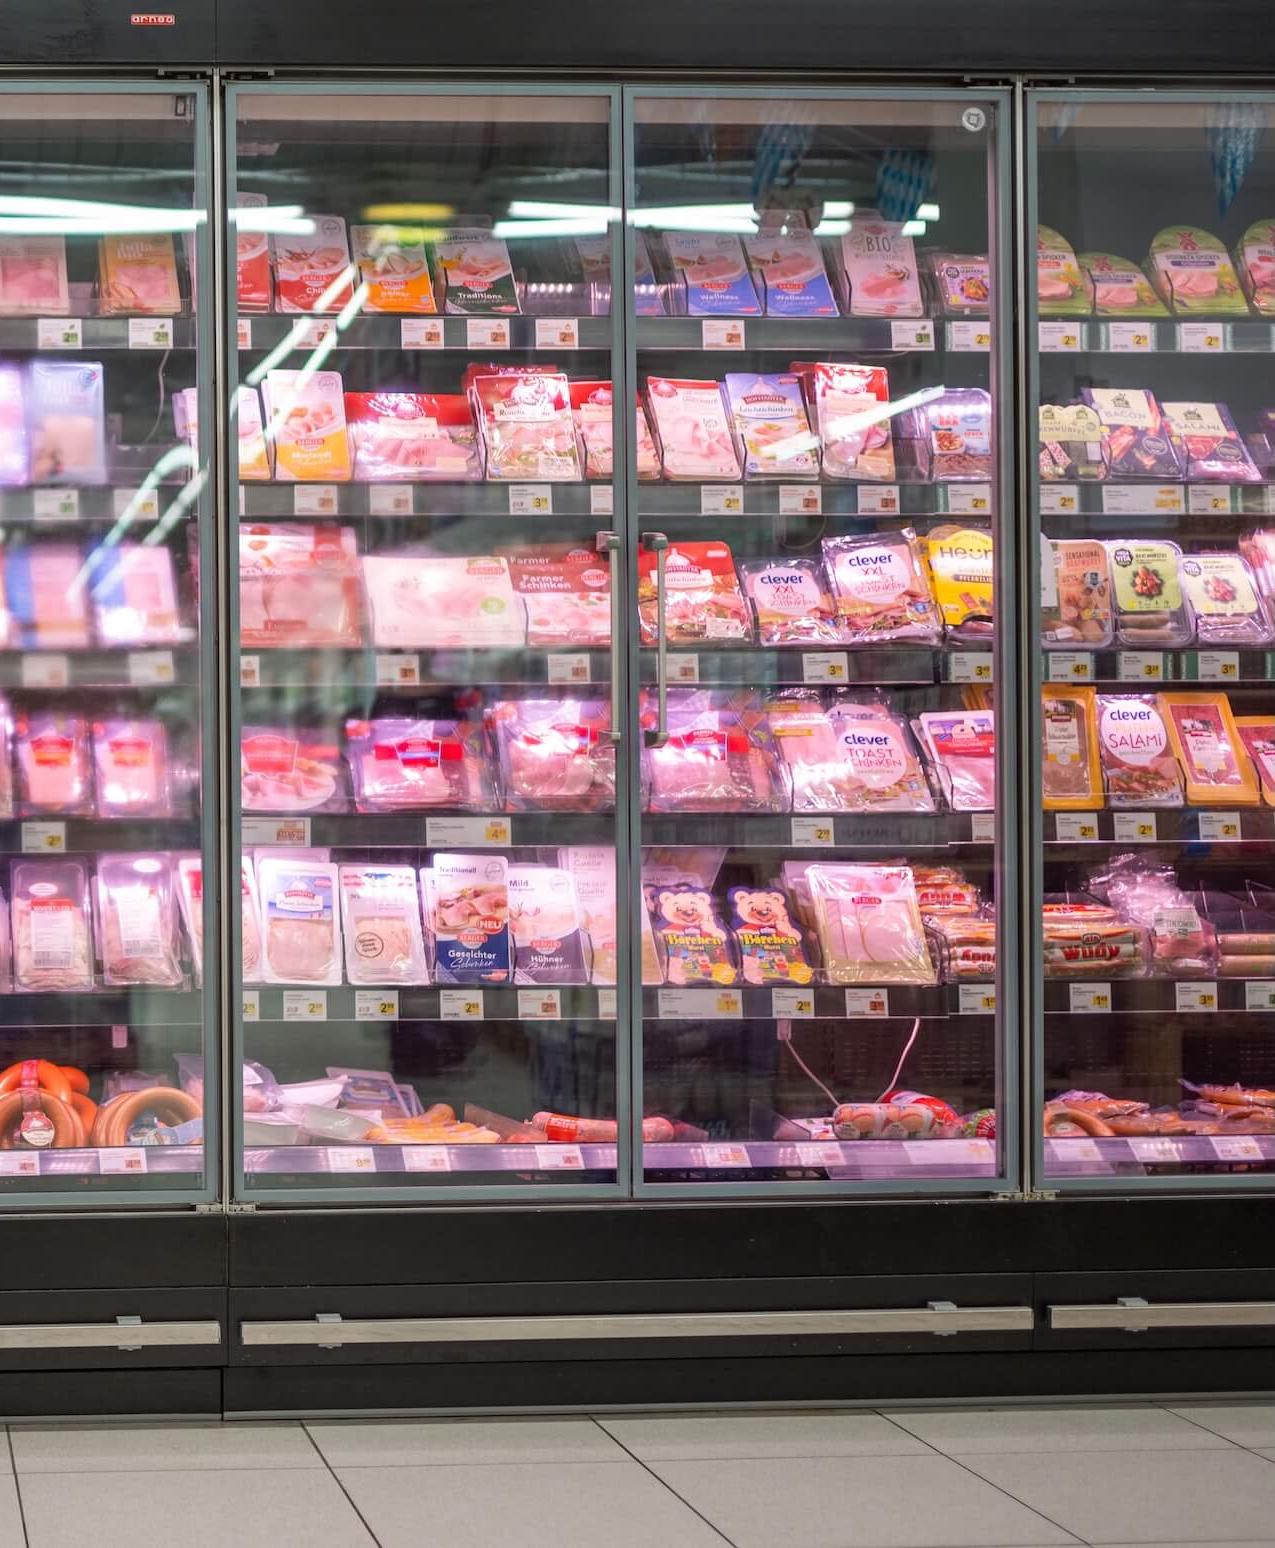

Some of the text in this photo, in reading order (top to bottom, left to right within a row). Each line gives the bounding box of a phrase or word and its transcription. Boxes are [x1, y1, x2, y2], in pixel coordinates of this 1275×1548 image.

[866, 235, 891, 252] BIO
[848, 553, 893, 567] clever
[861, 567, 884, 576] XXL
[760, 575, 803, 585] clever
[773, 586, 795, 594] XXL
[1109, 709, 1152, 721] clever
[844, 733, 889, 745] clever
[845, 748, 895, 758] TOAST
[844, 759, 902, 767] CHINKEN
[509, 879, 529, 887] Mild
[479, 919, 502, 929] NEU
[1060, 943, 1121, 961] Wudy
